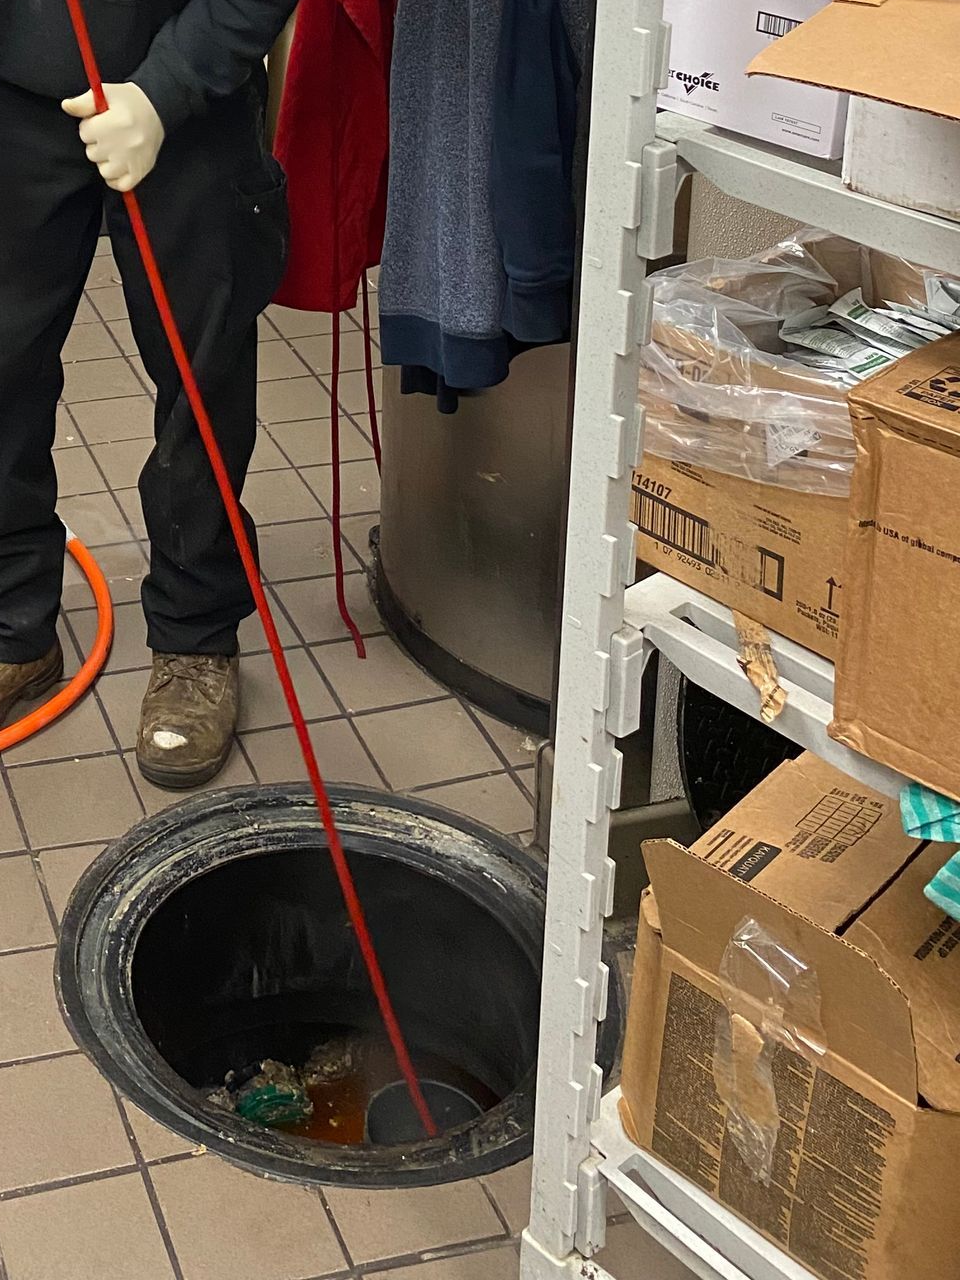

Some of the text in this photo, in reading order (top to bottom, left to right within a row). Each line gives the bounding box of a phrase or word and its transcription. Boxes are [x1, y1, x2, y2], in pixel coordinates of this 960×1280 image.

[676, 71, 720, 92] CHOICE
[883, 527, 900, 540] USA
[901, 535, 909, 544] of
[910, 538, 934, 554] global
[662, 546, 673, 556] 07
[676, 552, 702, 570] 92493
[737, 845, 772, 876] KAYQUAT
